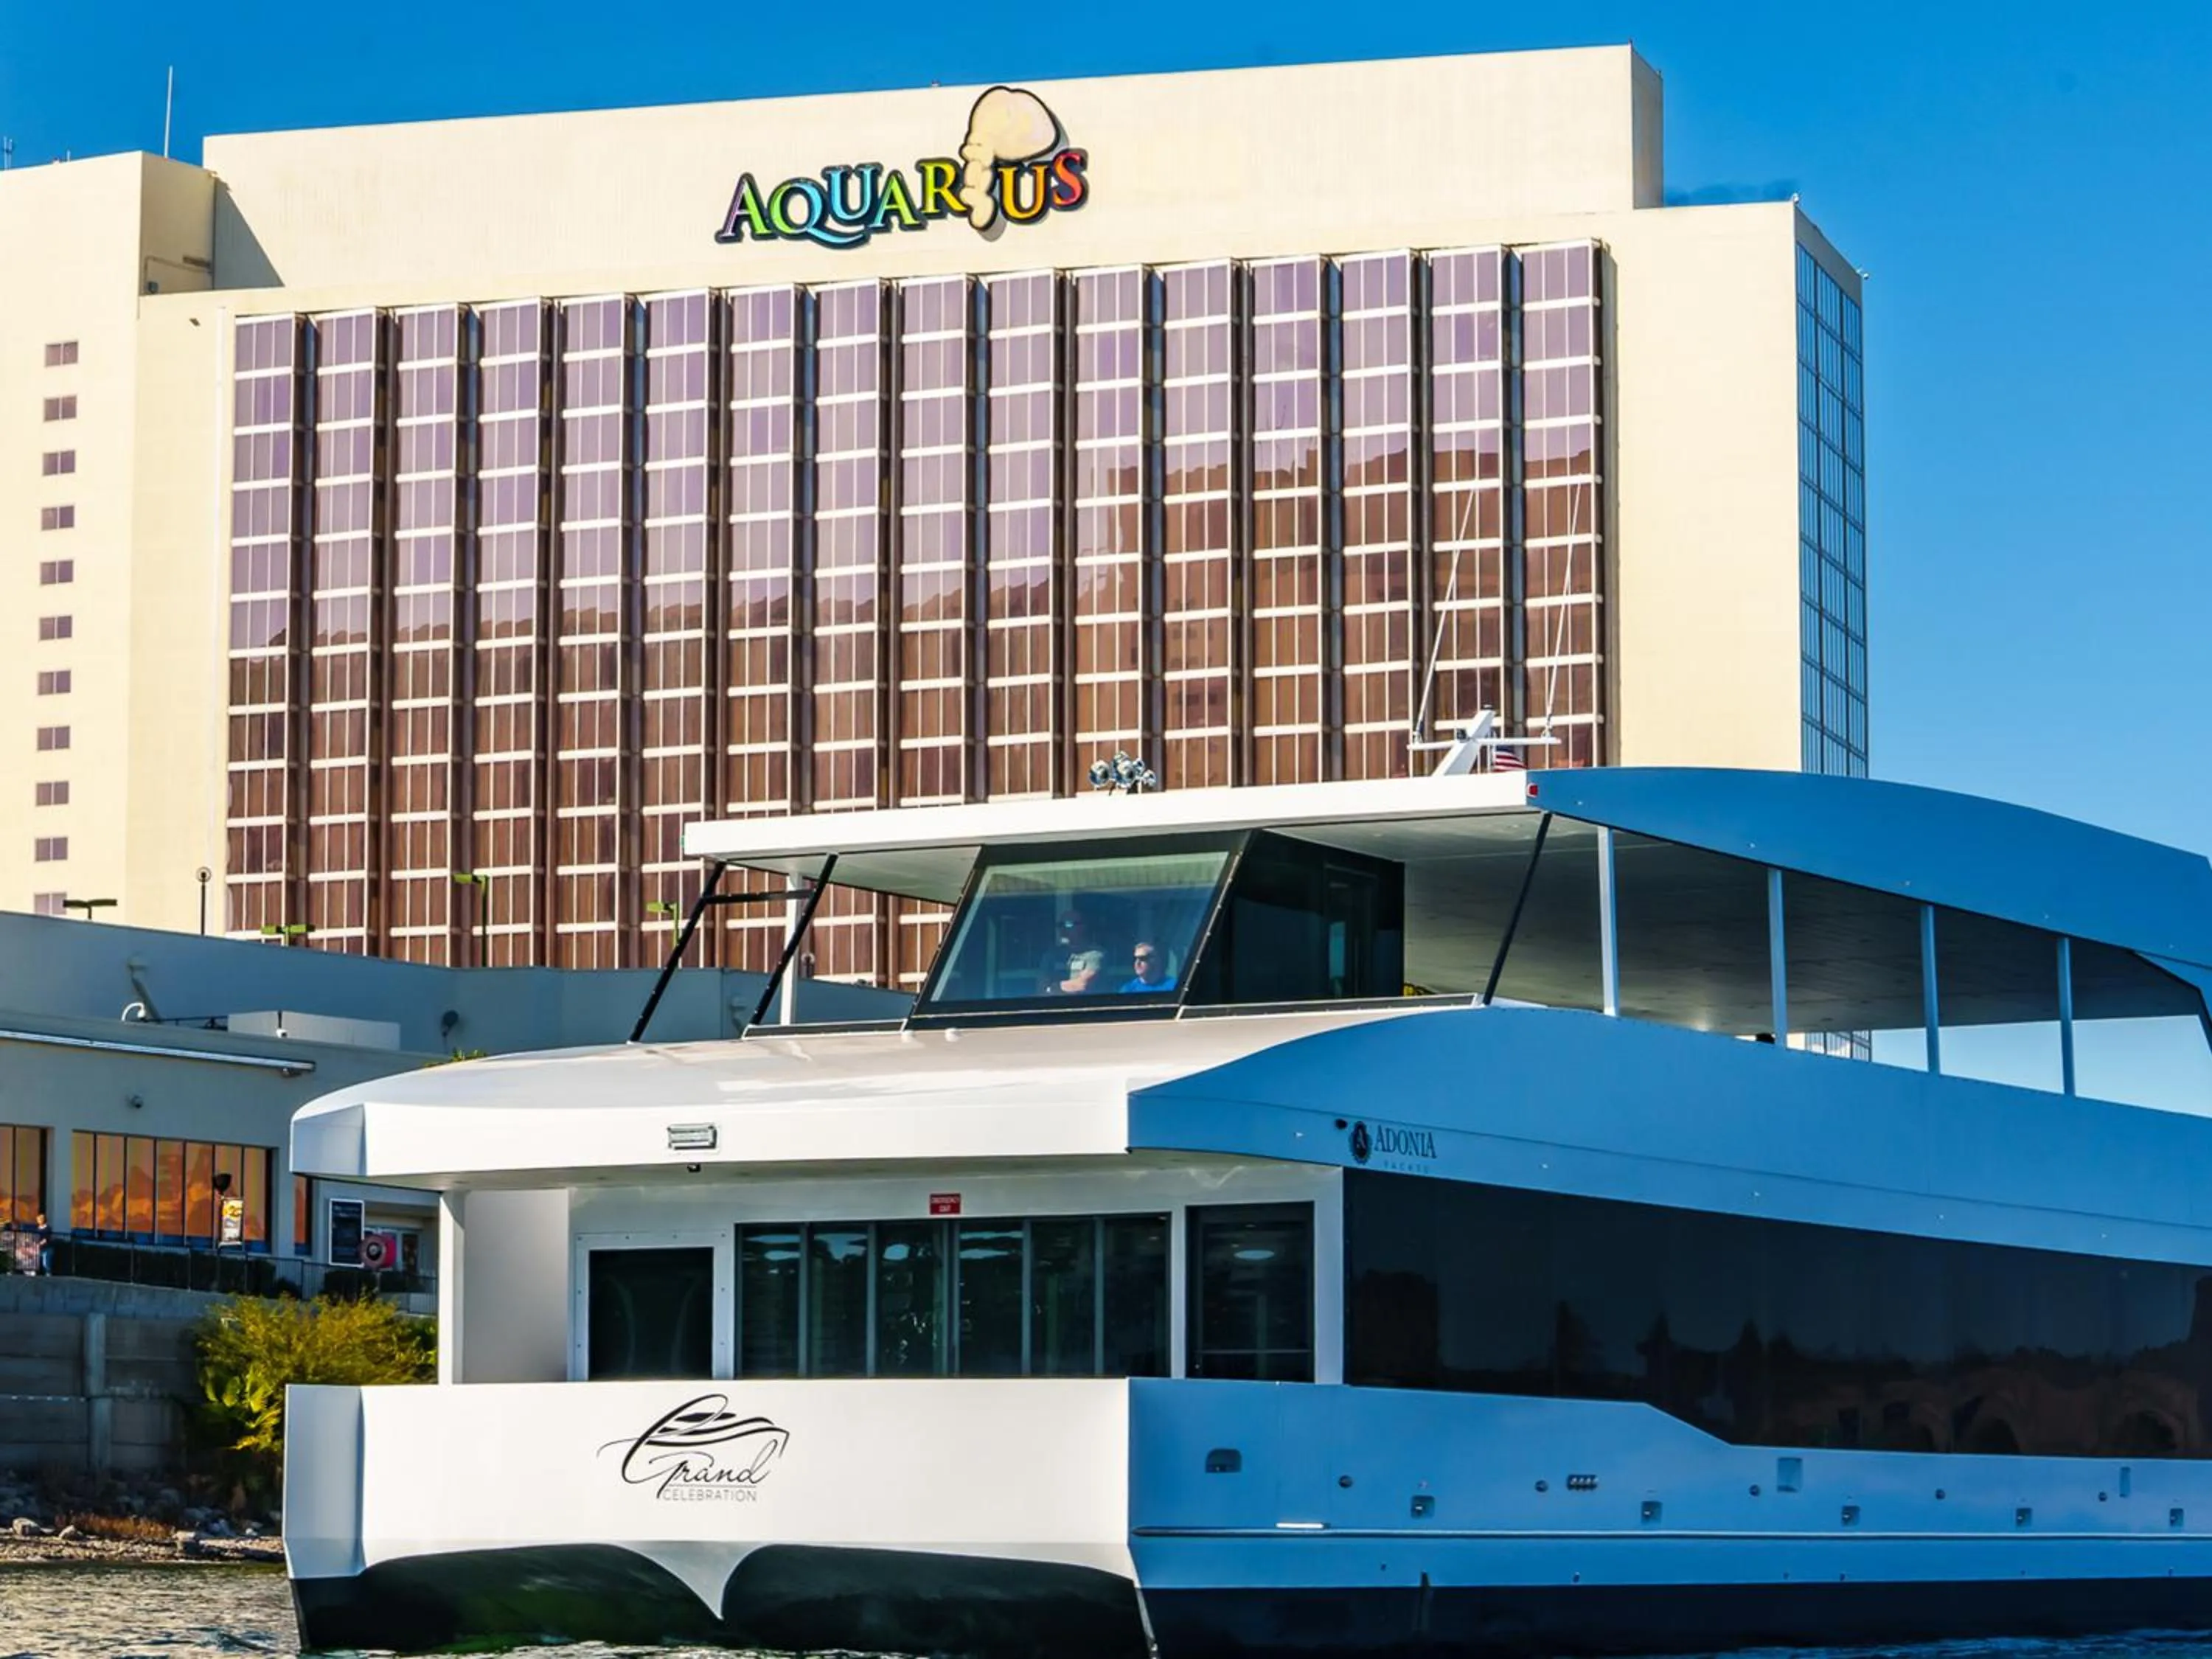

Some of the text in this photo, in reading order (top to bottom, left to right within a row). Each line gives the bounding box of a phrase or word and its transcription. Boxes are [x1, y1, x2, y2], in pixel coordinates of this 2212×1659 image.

[1374, 1124, 1437, 1159] ADONIA
[619, 1394, 778, 1499] Grand
[663, 1488, 757, 1502] CELEBRATION
